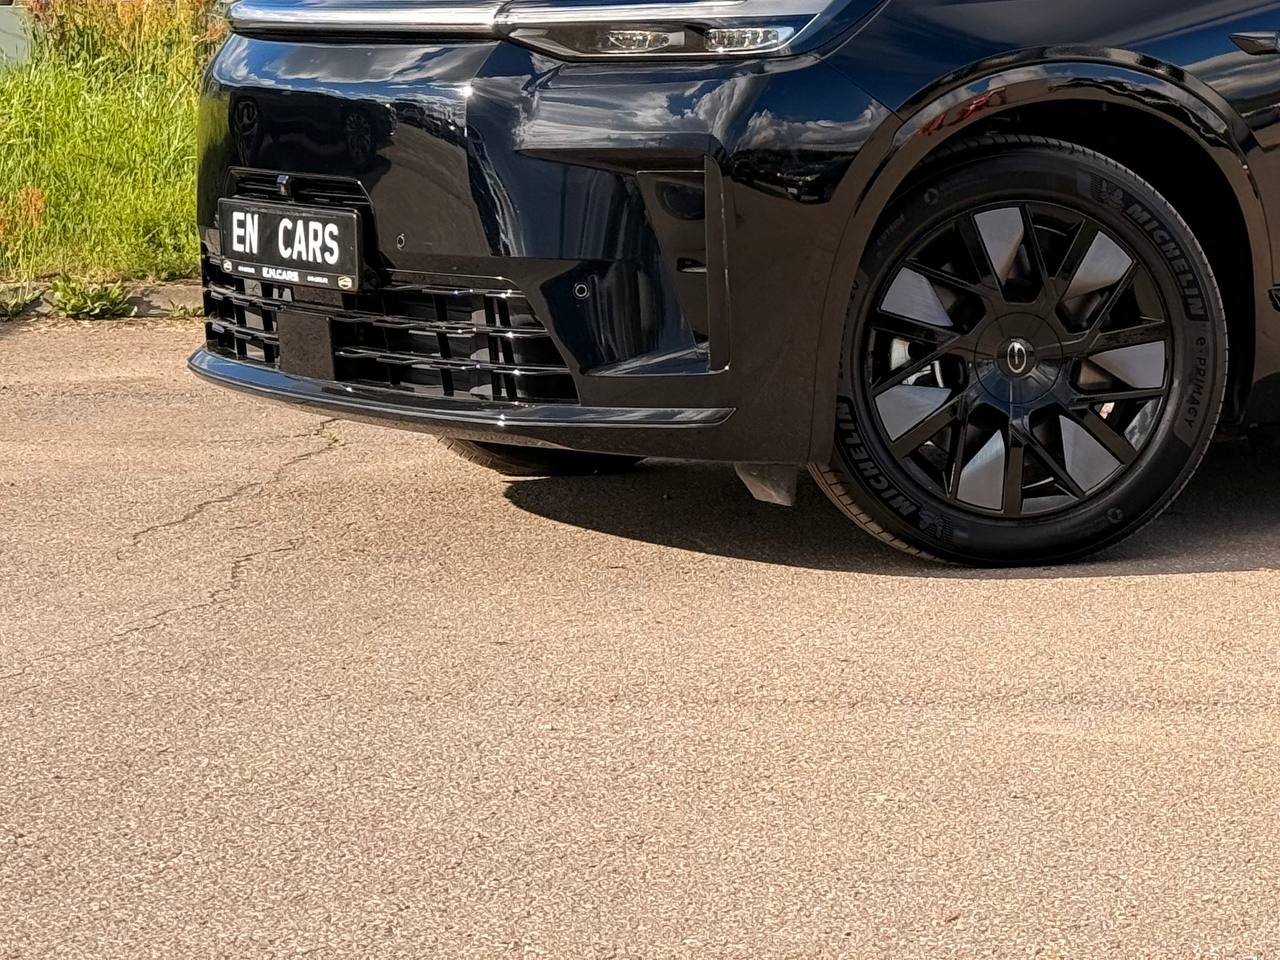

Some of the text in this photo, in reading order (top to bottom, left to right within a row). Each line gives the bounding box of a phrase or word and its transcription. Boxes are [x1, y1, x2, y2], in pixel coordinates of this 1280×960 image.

[232, 211, 339, 265] EN CARS
[1126, 202, 1208, 319] MICHELIN
[836, 401, 919, 517] MICHELIN
